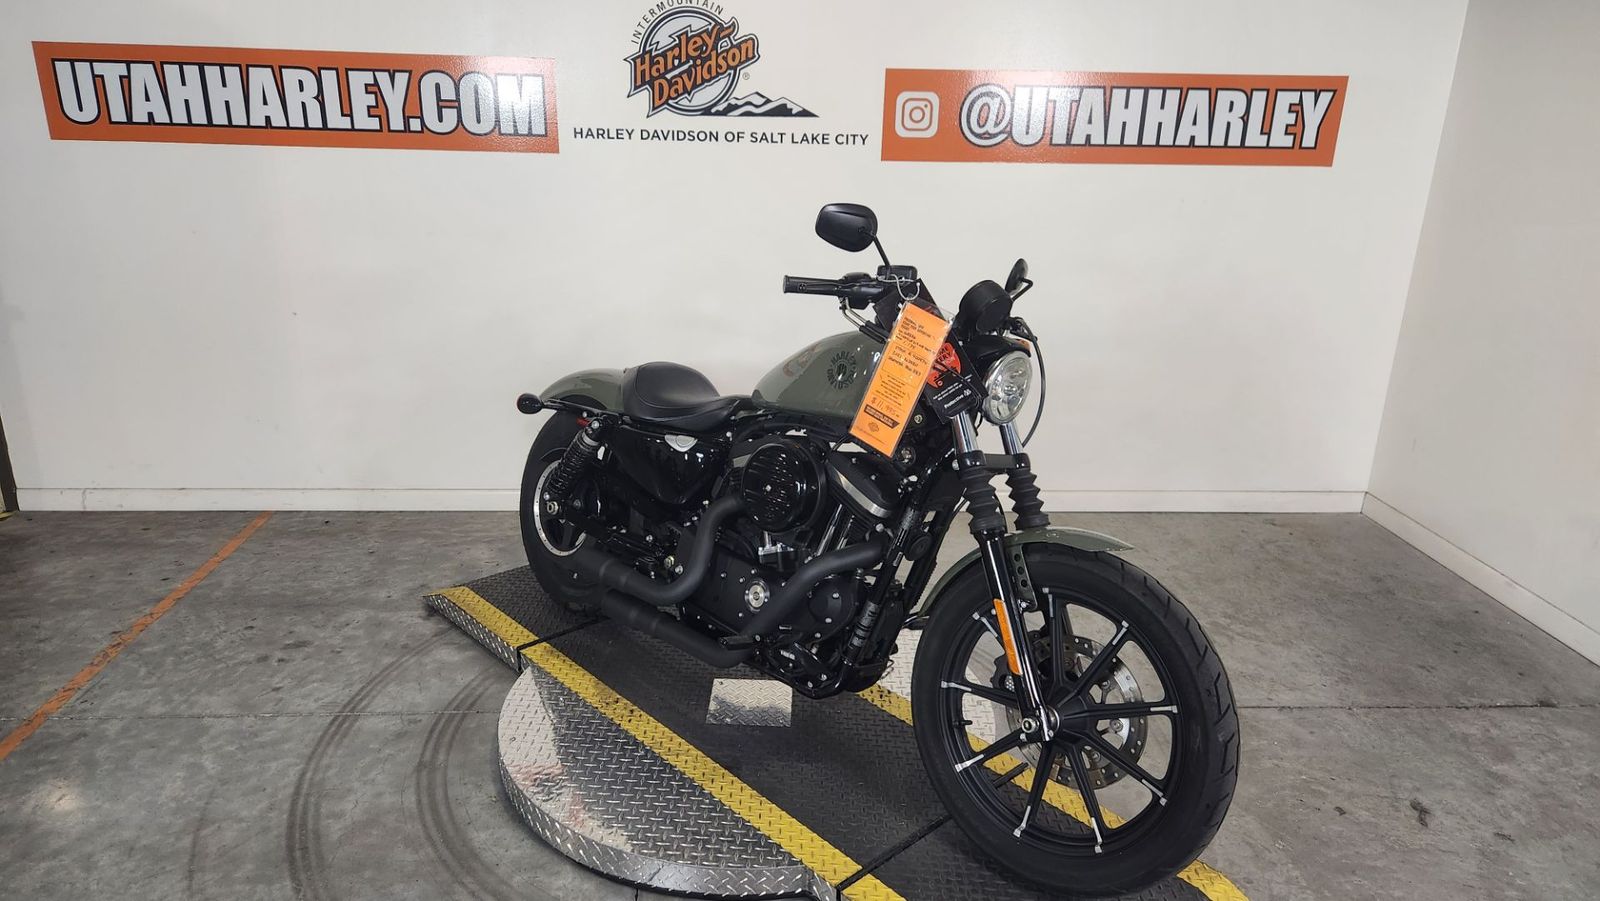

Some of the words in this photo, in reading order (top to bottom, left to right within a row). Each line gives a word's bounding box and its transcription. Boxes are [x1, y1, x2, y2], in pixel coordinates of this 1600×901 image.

[51, 57, 549, 138] UTAHHARLEY.COM
[652, 38, 755, 108] Davidson
[573, 127, 635, 140] HARLEY
[640, 128, 719, 142] DAVIDSON
[724, 130, 745, 143] OF
[750, 131, 787, 144] SALT
[791, 132, 830, 145] LAKE
[834, 133, 869, 146] CITY
[959, 83, 1337, 149] @UTAHHARLEY
